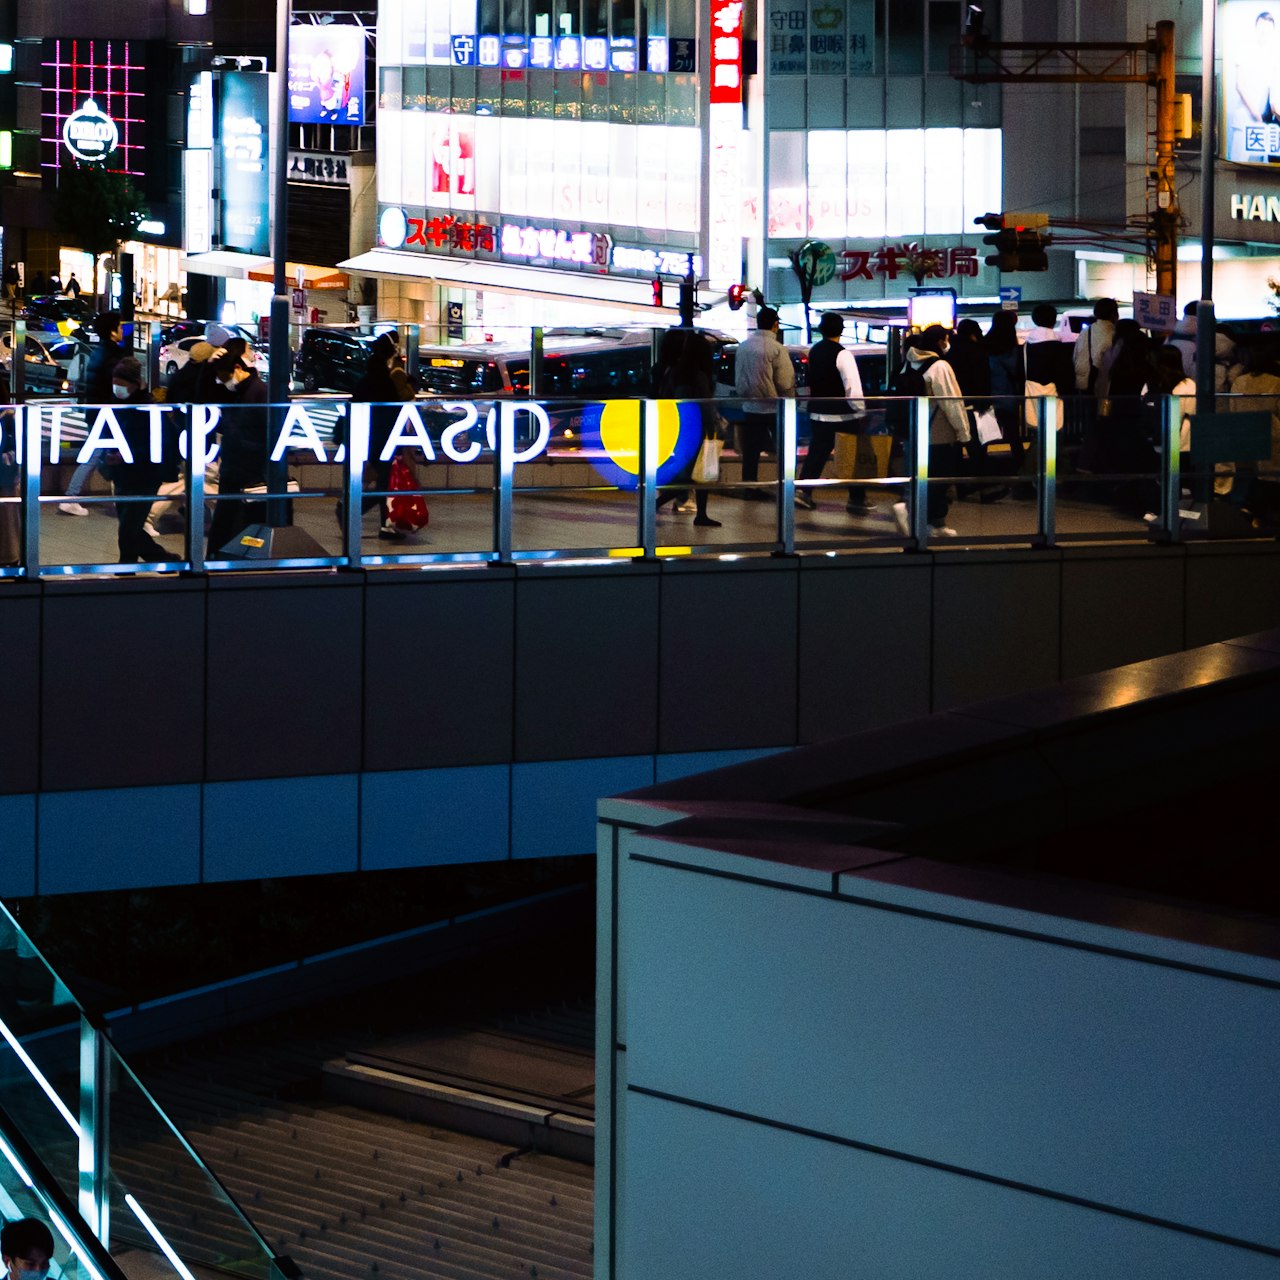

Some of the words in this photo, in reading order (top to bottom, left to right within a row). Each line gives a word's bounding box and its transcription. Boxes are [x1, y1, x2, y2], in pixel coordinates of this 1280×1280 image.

[771, 10, 805, 31] 守田
[454, 34, 499, 66] 守田
[771, 35, 868, 54] 耳鼻咽喉科
[406, 213, 495, 253] スギ薬局
